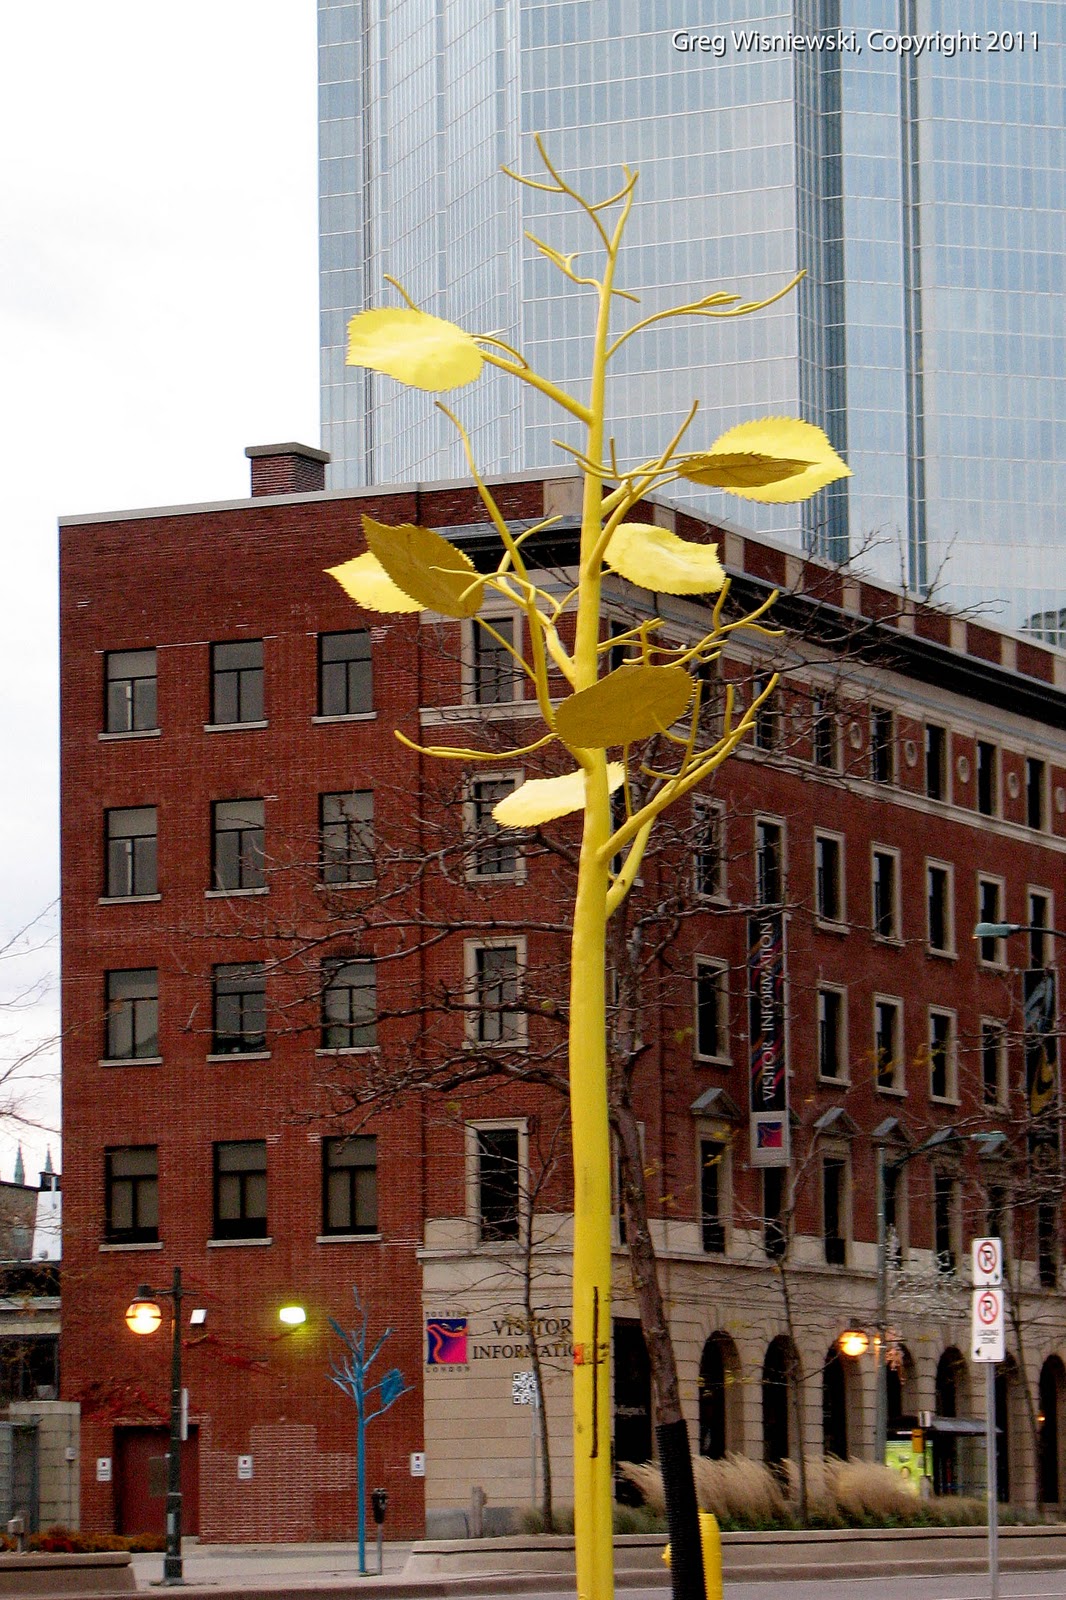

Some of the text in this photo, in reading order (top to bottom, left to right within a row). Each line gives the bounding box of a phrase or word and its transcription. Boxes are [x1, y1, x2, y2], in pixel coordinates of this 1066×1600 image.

[760, 922, 776, 1101] VISITOR INFORMATION
[472, 1343, 574, 1360] INFORATI
